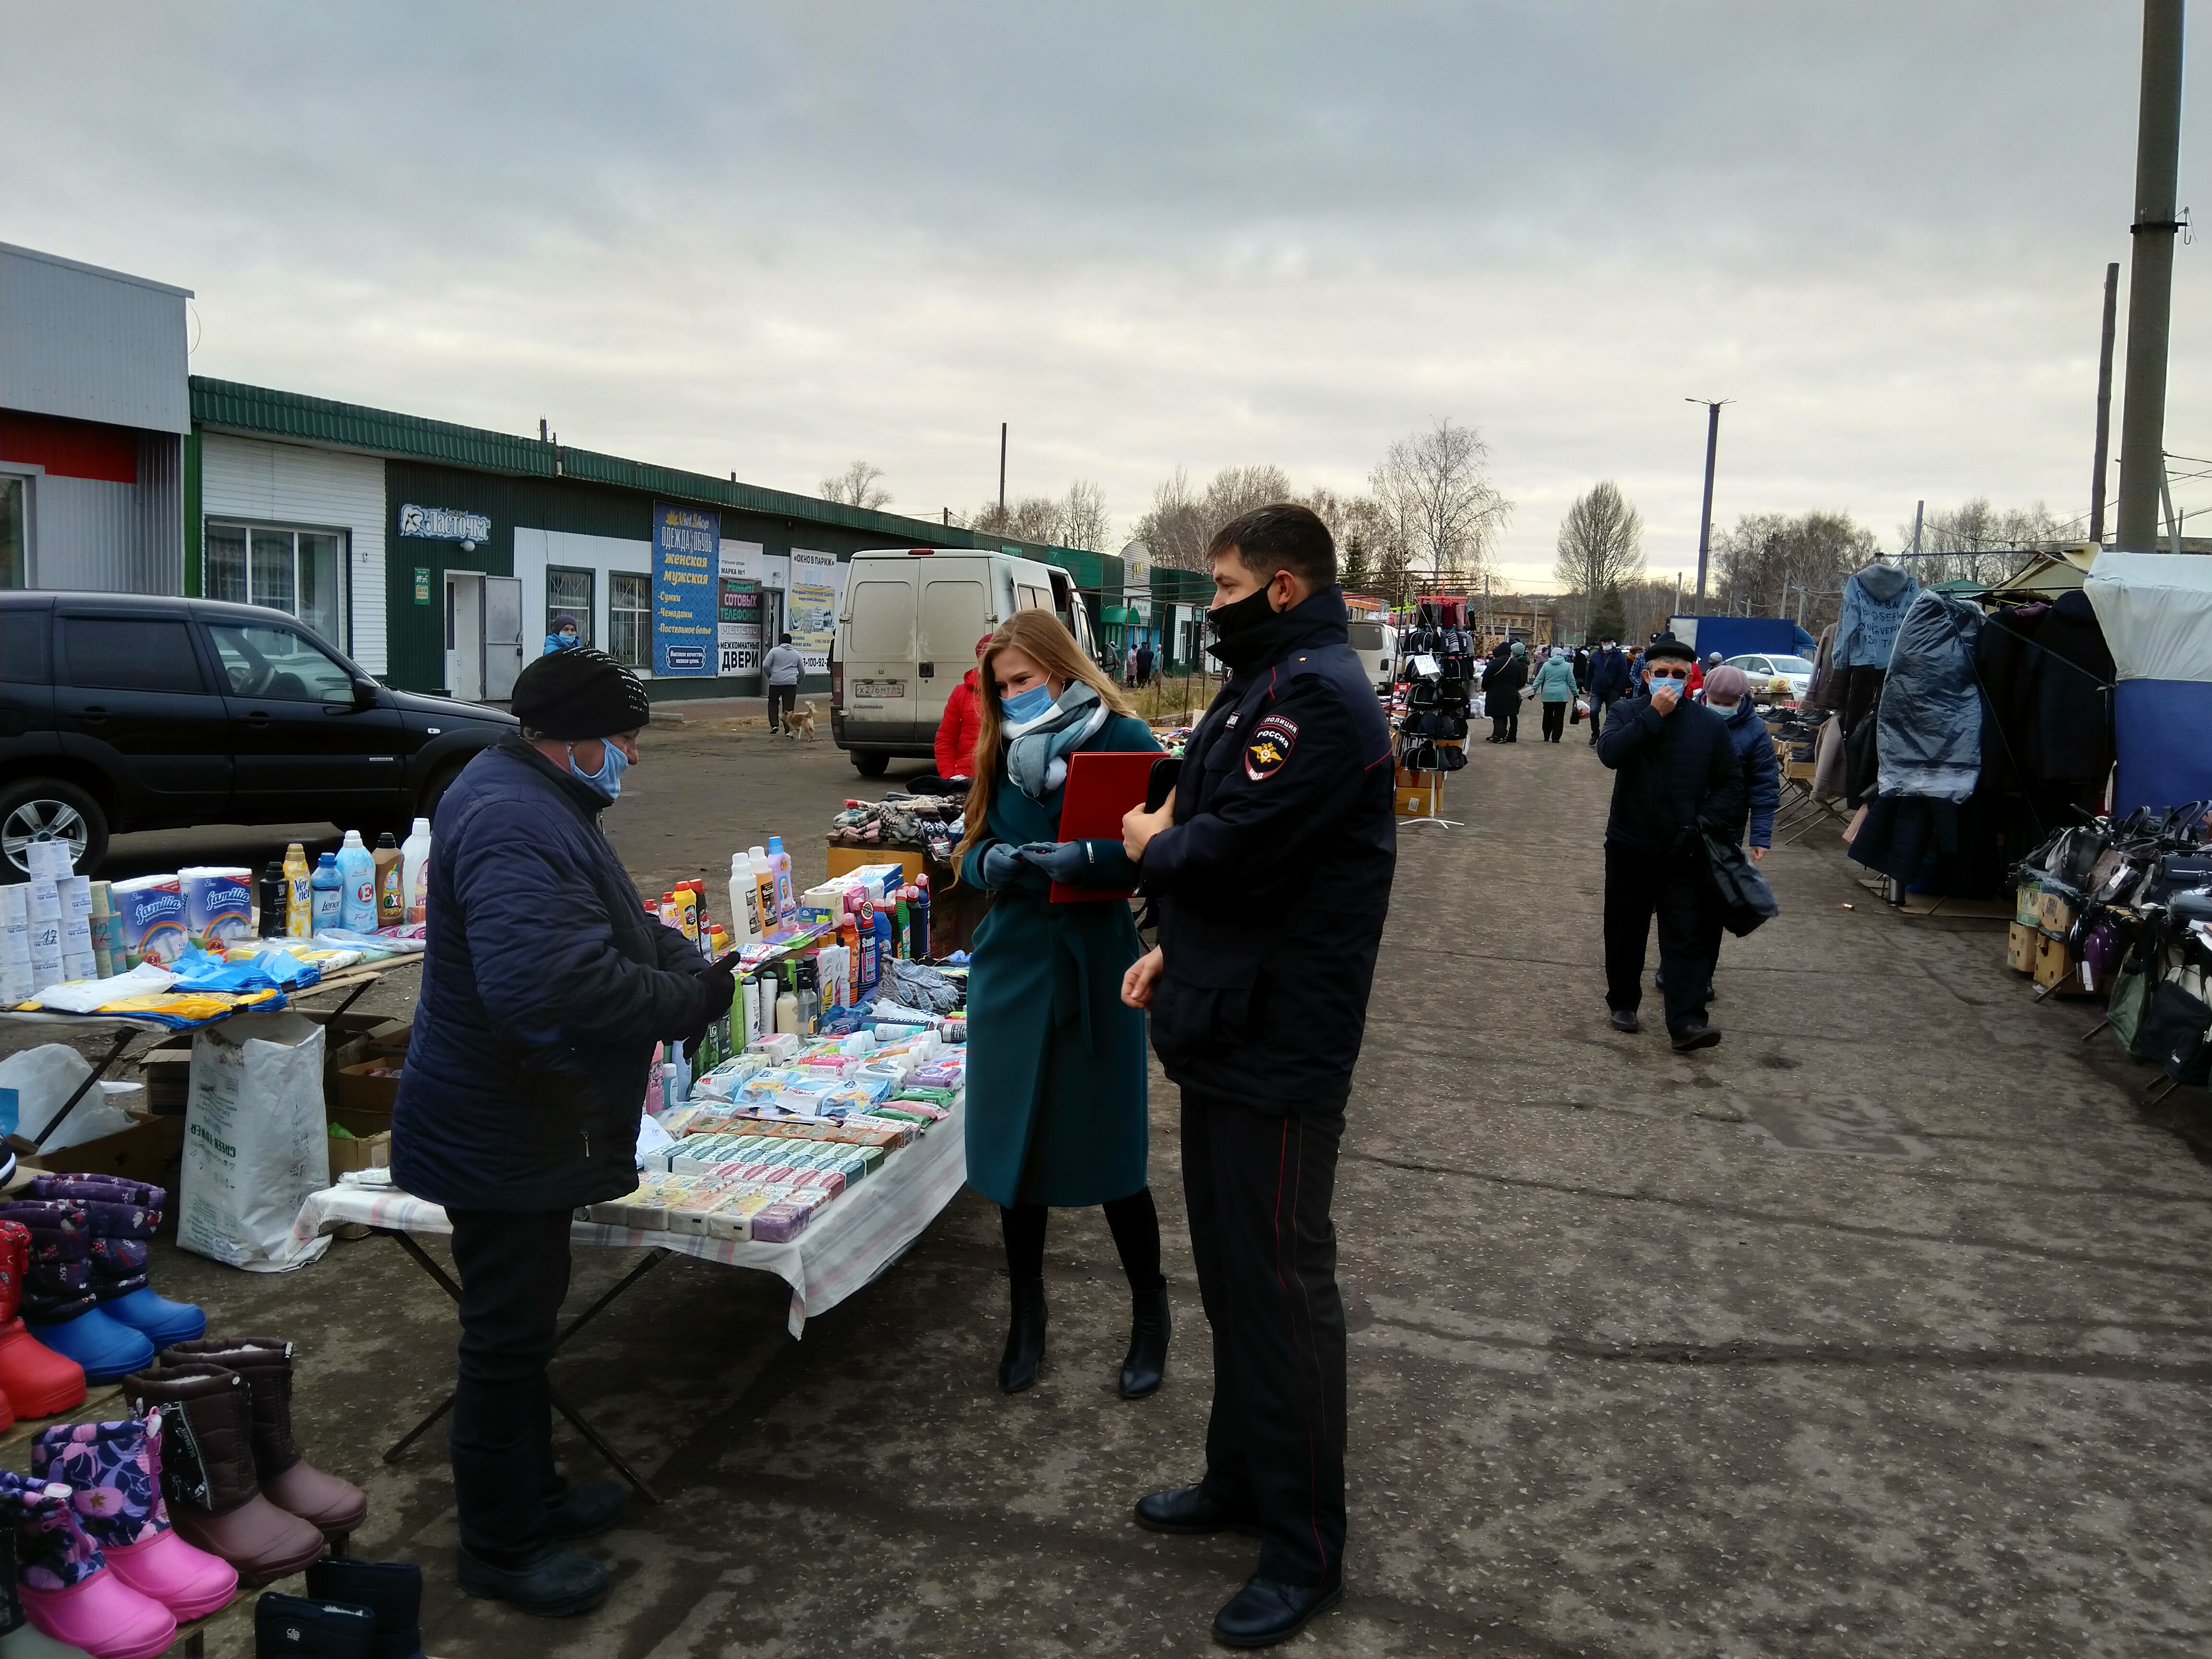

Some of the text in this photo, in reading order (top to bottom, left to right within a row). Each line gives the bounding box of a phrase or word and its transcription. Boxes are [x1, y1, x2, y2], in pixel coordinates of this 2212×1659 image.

[679, 511, 709, 530] Viet Shop
[661, 526, 712, 553] ОДЕЖДА ОБУВЬ
[665, 553, 708, 568] женская
[794, 553, 835, 566] «ОКНО В ПАРИЖ»
[663, 570, 709, 586] мужская
[727, 579, 756, 593] РЕМОНТ
[724, 593, 757, 607] СОТОВЫХ
[720, 607, 760, 621] ТЕЛЕФОНОВ
[695, 625, 712, 635] белье
[720, 641, 760, 649] МЕЖКОМНАТНЫЕ
[721, 651, 758, 672] ДВЕРИ
[1264, 717, 1298, 734] ПОЛИЦИЯ
[1256, 730, 1289, 748] РОССИЯ
[1249, 768, 1264, 781] МВД
[294, 878, 308, 893] Ver
[361, 884, 373, 902] E
[206, 888, 250, 911] familia
[321, 901, 341, 912] Lenor
[135, 895, 181, 926] familia
[214, 1136, 236, 1158] GREEN
